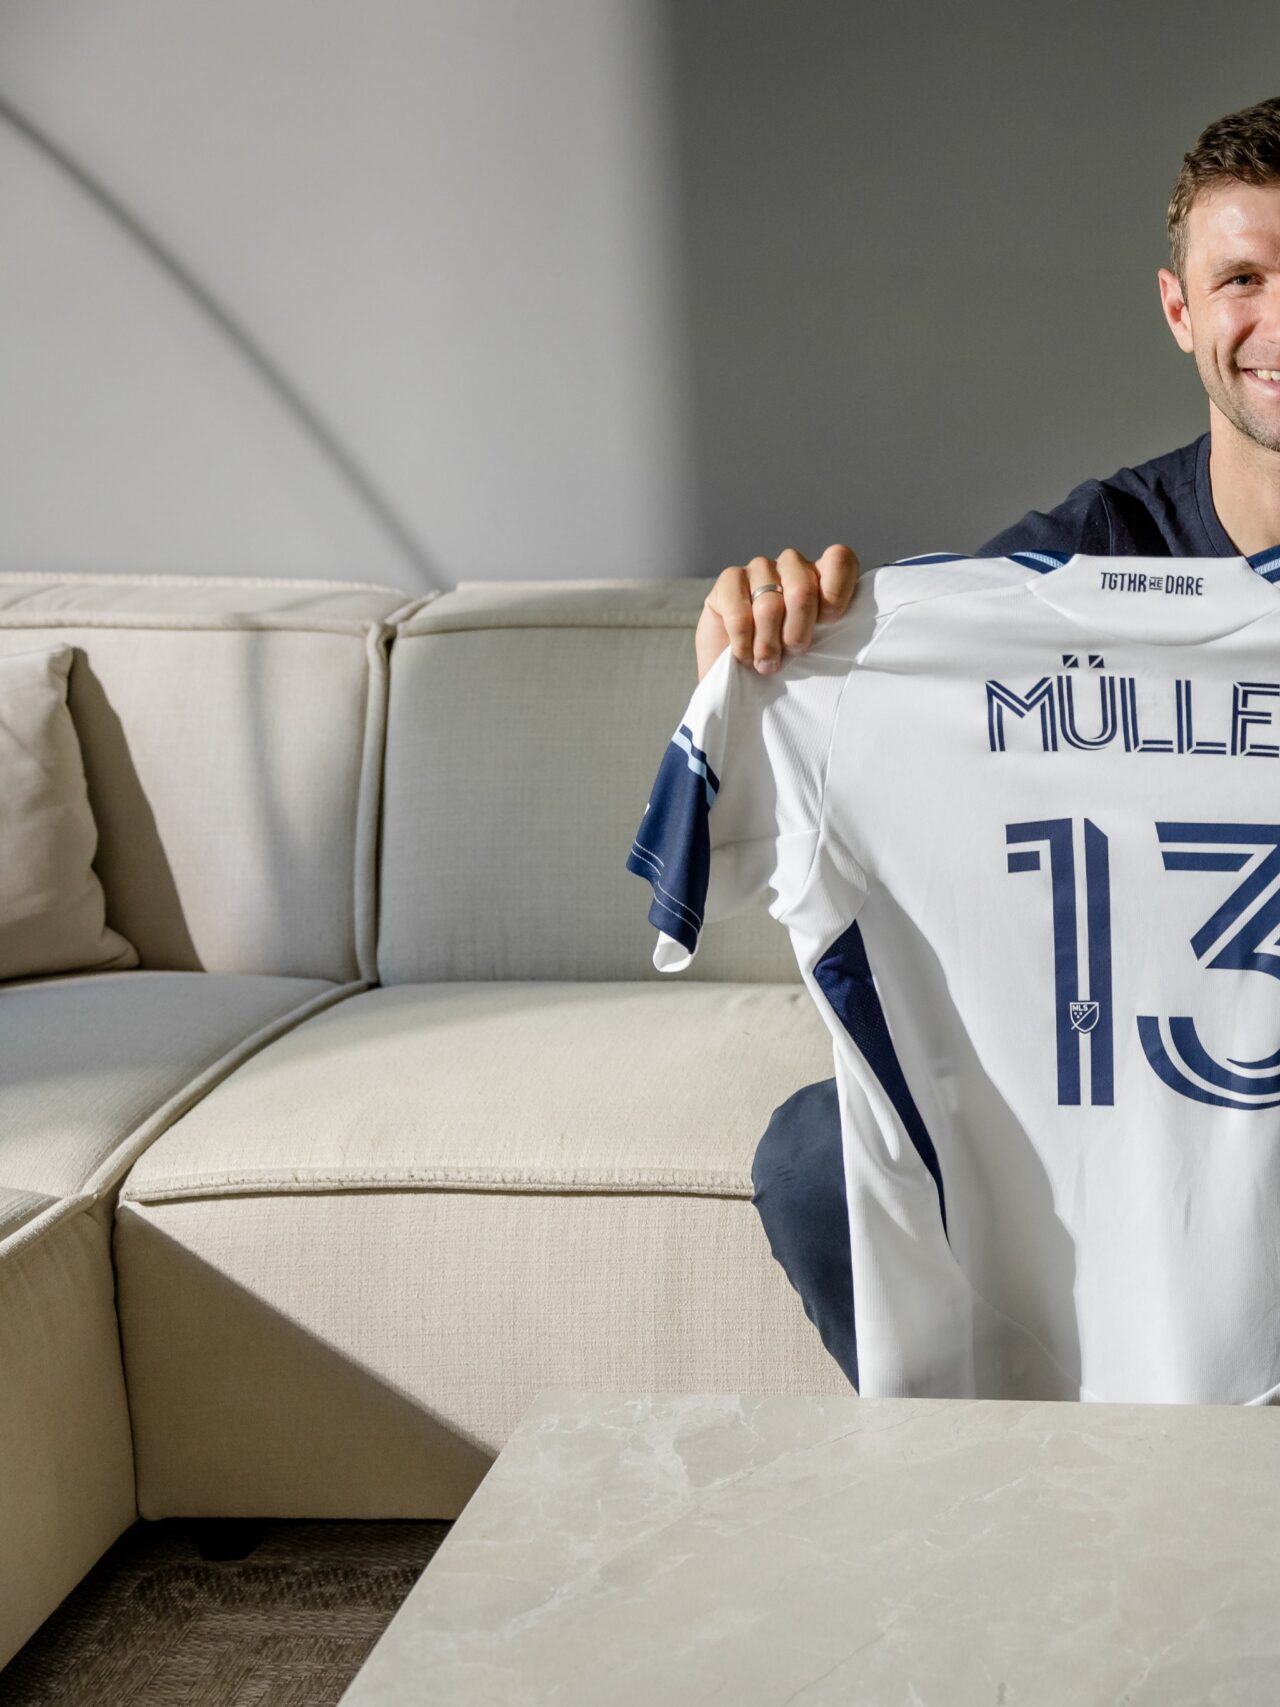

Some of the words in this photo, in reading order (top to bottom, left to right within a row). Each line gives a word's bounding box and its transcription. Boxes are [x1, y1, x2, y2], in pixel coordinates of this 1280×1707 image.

[1100, 572, 1147, 593] TGTHR
[1149, 577, 1163, 590] WE
[1165, 575, 1205, 596] DARE
